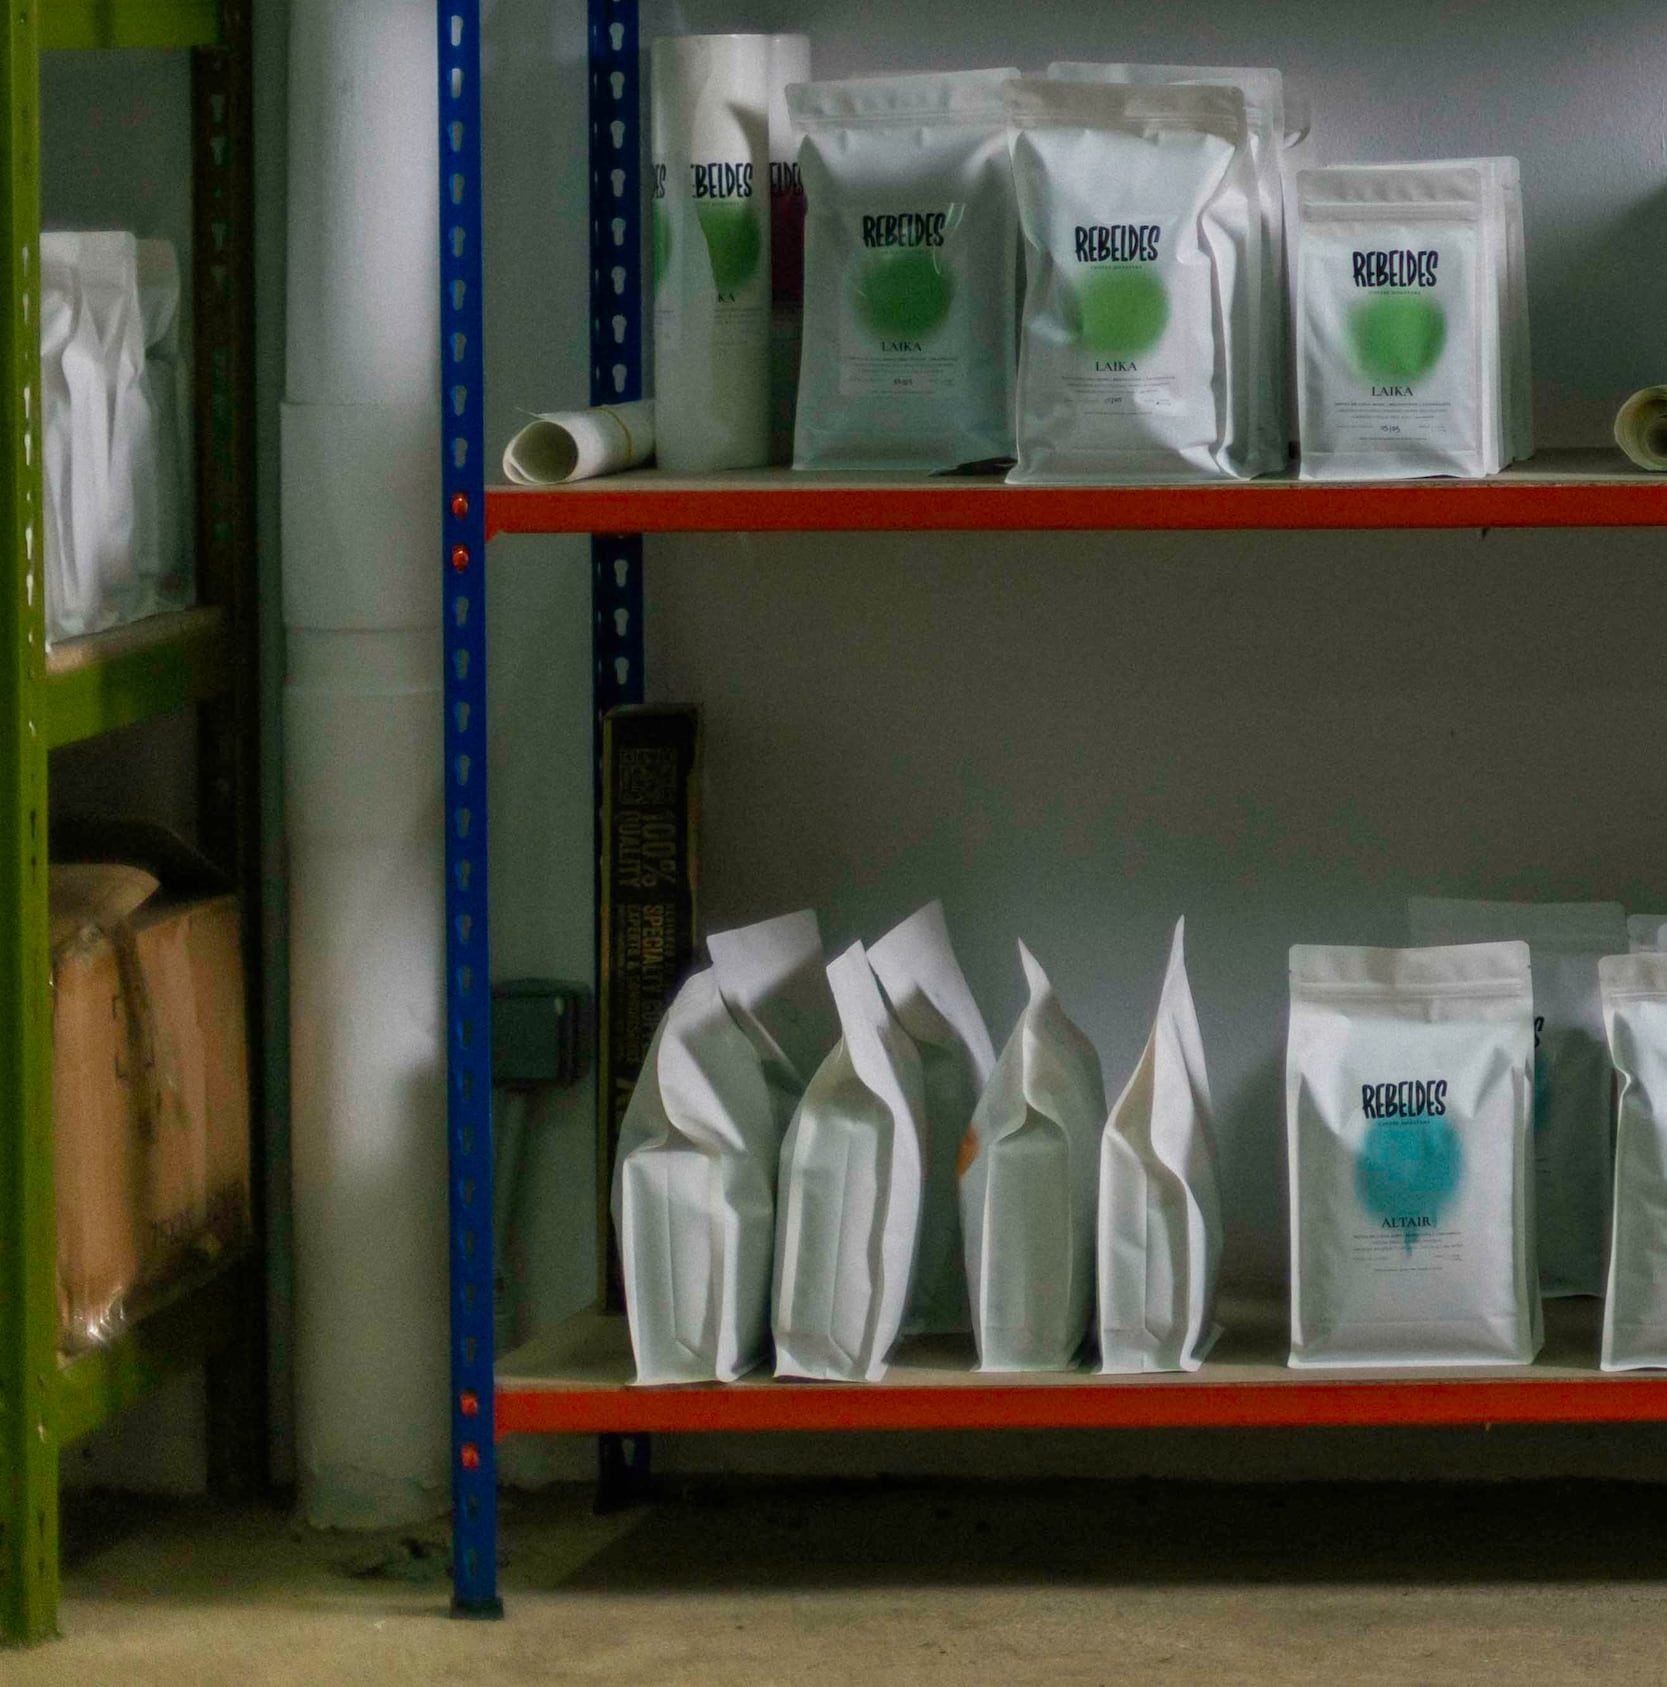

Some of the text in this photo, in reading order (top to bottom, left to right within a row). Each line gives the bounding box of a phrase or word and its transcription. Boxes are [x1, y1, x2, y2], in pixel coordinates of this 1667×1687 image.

[691, 162, 753, 198] BELDES
[863, 212, 946, 248] REBELDES
[1075, 224, 1161, 262] REBELDES
[1352, 250, 1439, 288] REBELDES
[881, 342, 922, 353] LAIKA
[1095, 361, 1137, 372] LAIKA
[1371, 386, 1413, 397] LAIKA
[616, 811, 640, 887] QUALITY
[640, 811, 677, 887] 100%
[641, 904, 663, 994] SPECIALTY
[1362, 1080, 1448, 1119] REBELDES
[1381, 1216, 1431, 1229] ALTAIR
